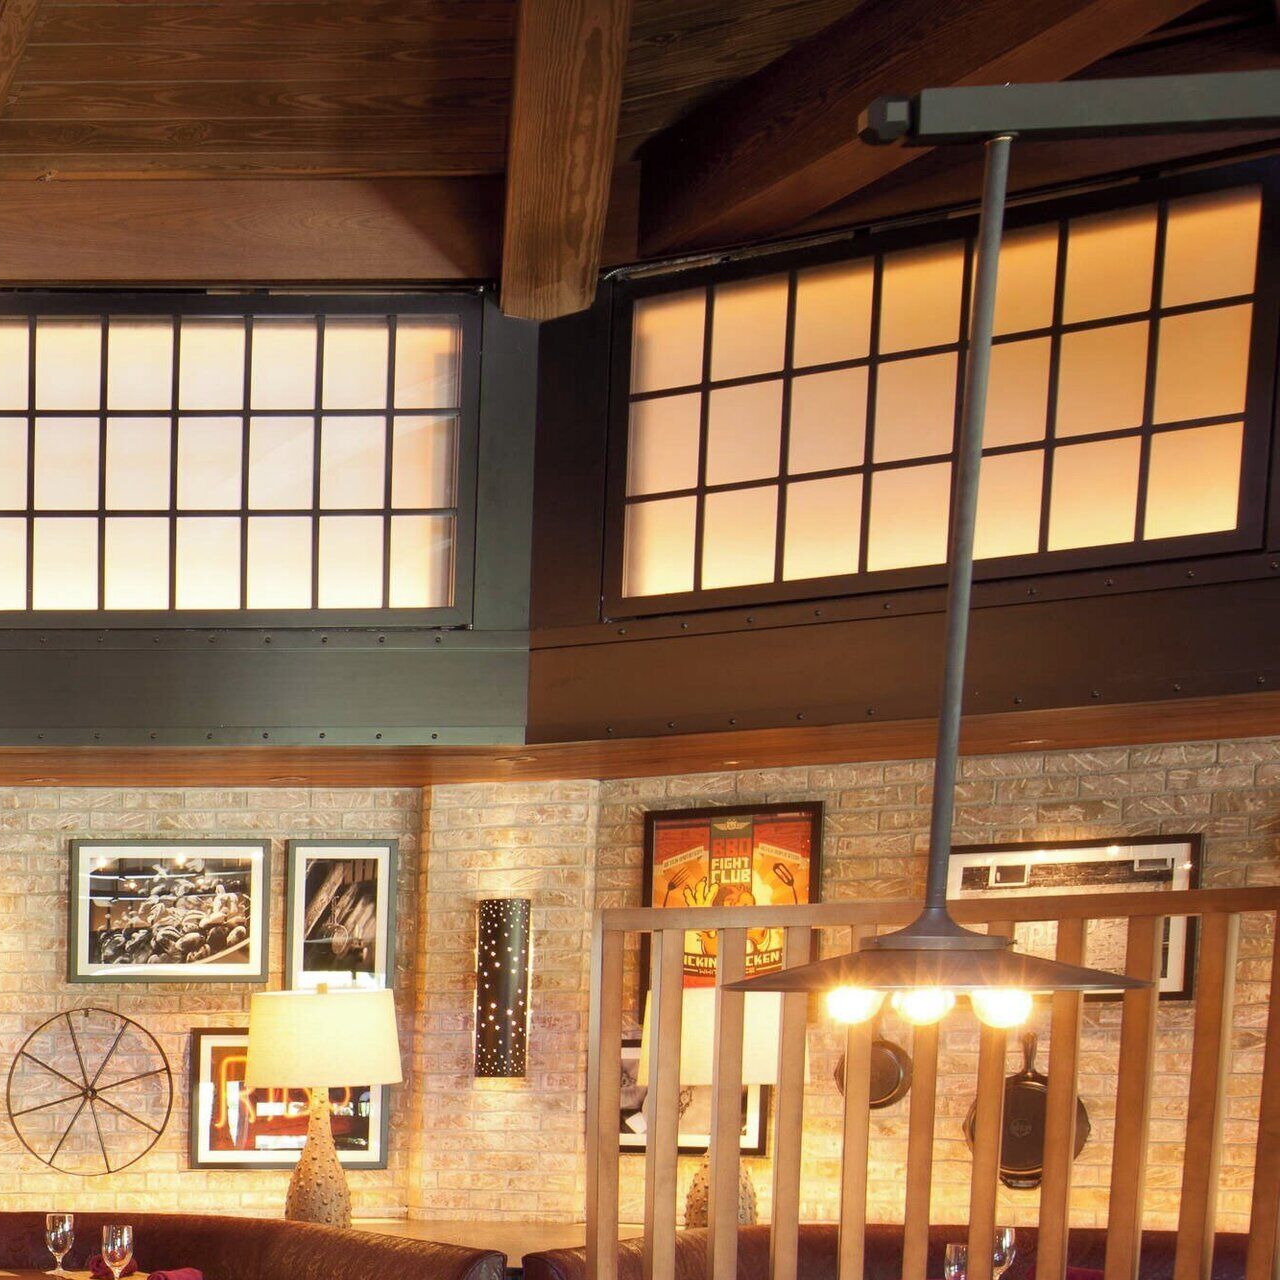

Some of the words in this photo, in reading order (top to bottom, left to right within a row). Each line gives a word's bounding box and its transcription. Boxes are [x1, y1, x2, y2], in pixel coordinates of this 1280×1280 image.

[711, 857, 750, 869] FIGHT
[711, 868, 751, 883] CLUB
[683, 955, 717, 968] ICKIN
[745, 951, 780, 967] CKEN
